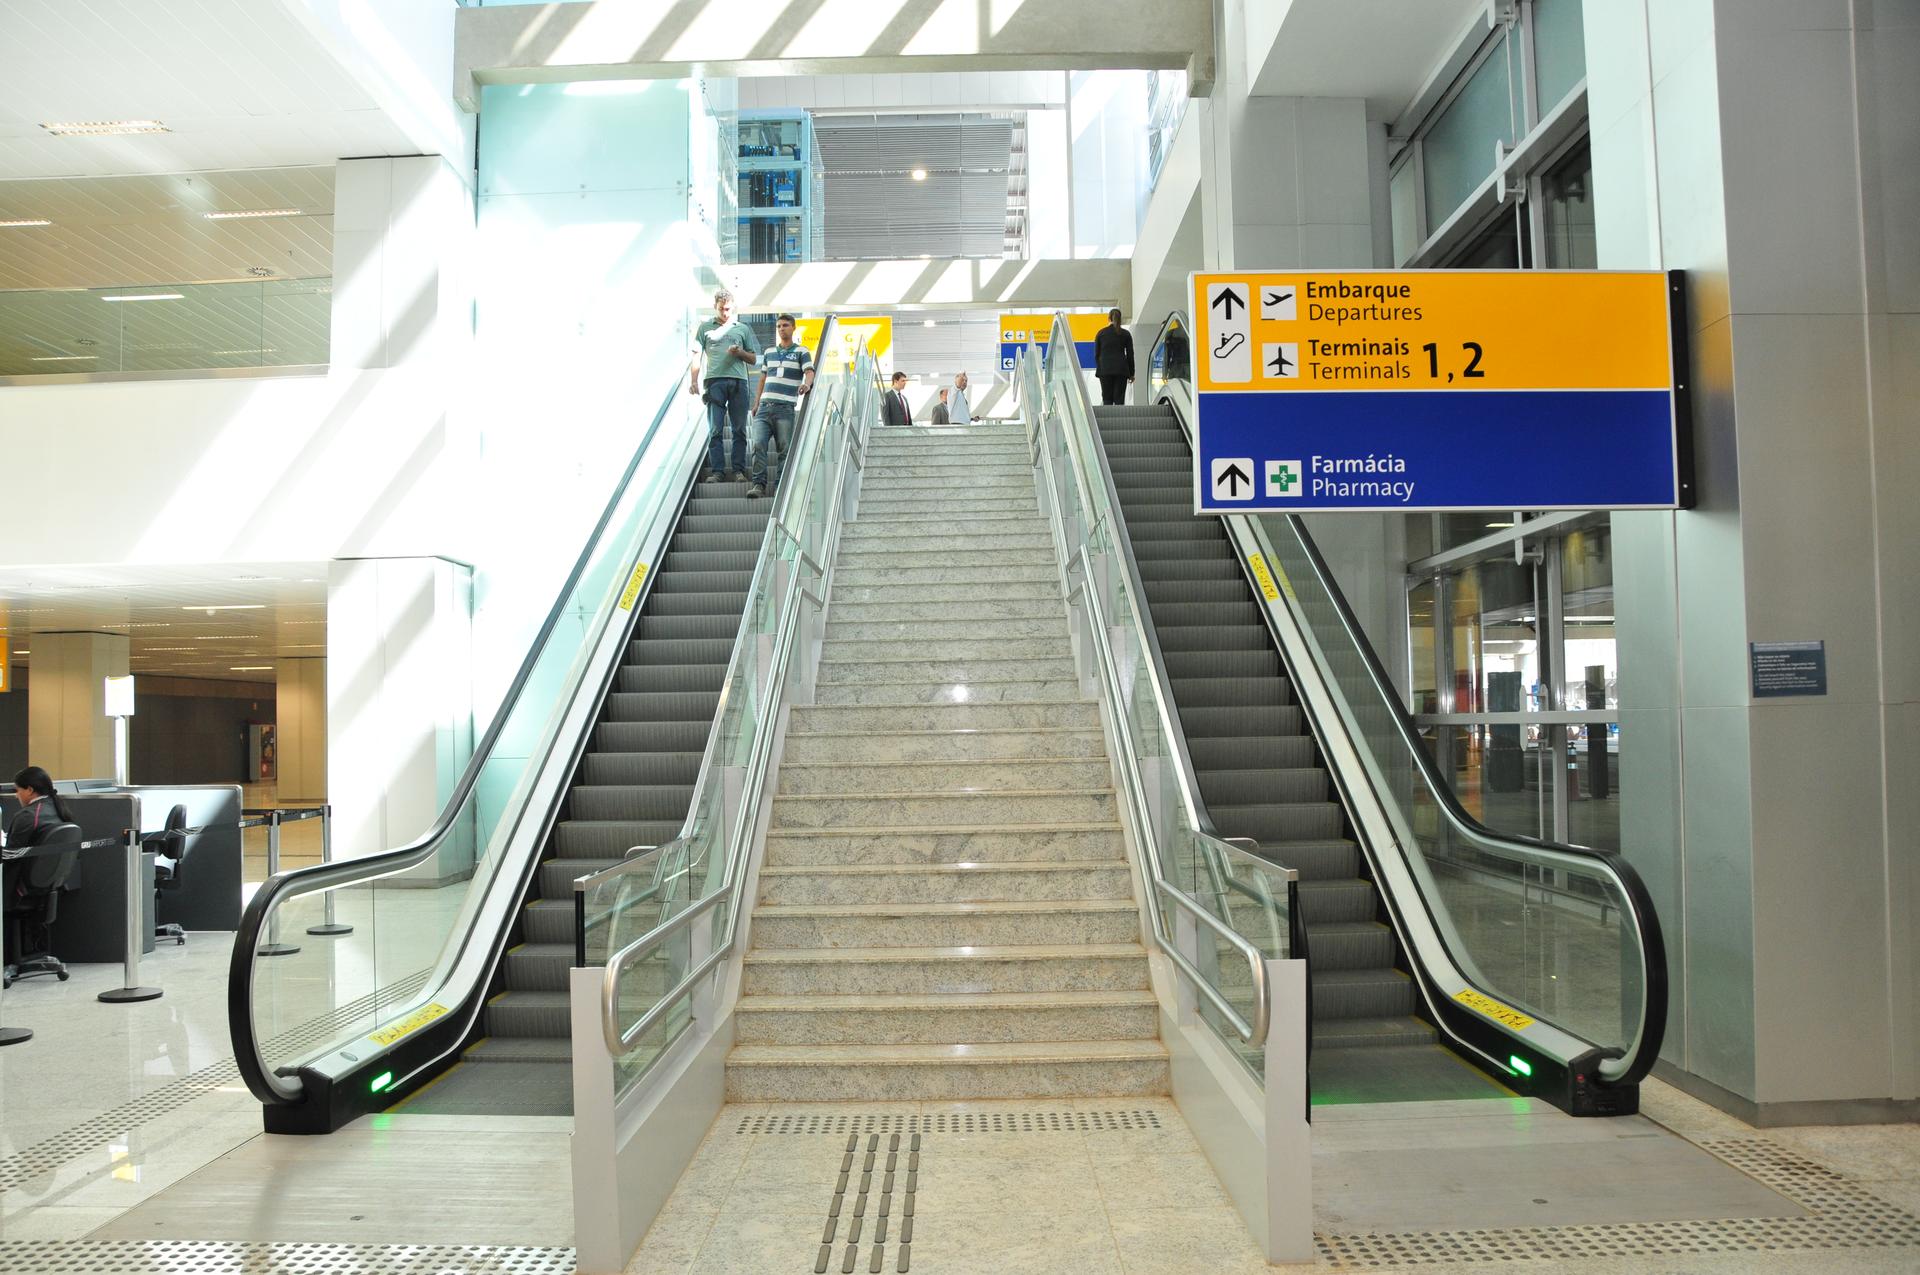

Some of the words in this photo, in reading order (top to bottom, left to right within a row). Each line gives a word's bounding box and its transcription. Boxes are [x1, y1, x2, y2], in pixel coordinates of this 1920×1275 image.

[1306, 280, 1411, 303] Embarque
[1309, 303, 1423, 326] Departures
[1307, 338, 1410, 357] Terminais
[1308, 361, 1411, 380] Terminals
[1312, 454, 1406, 473] Farmácia
[1312, 478, 1415, 501] Pharmacy
